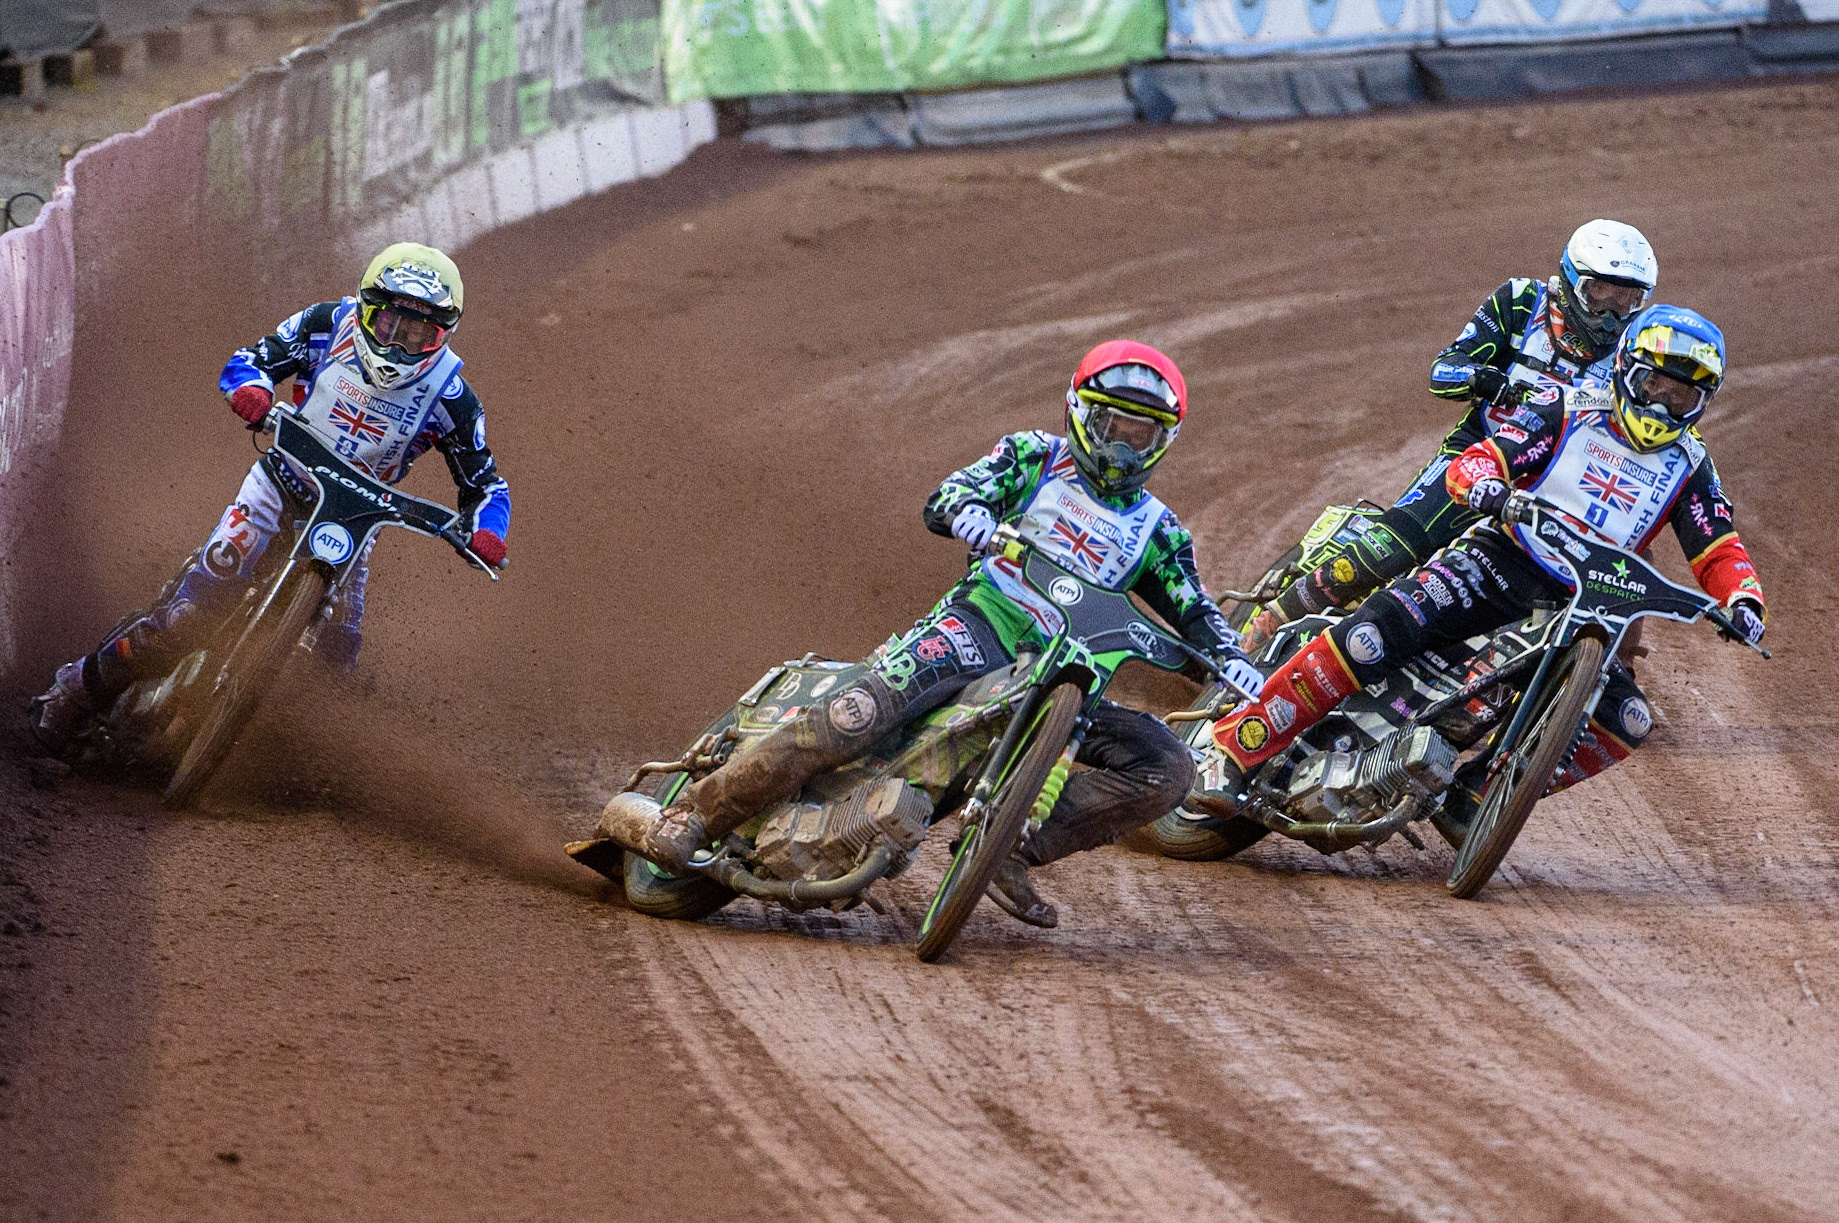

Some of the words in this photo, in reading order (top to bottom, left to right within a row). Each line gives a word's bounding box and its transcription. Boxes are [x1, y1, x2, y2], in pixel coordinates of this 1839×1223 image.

[336, 379, 369, 407] SPORTS
[367, 398, 403, 421] INSURE
[375, 440, 403, 475] ITISH
[399, 384, 430, 436] FINAL
[1586, 442, 1621, 468] SPORTS
[1621, 459, 1656, 485] INSURE
[1650, 451, 1682, 505] FINAL
[1060, 495, 1095, 525] SPORTS
[1093, 519, 1123, 548] INSU
[1117, 512, 1147, 568] FINAL
[316, 533, 345, 554] ATPI
[1470, 547, 1509, 591] STELLAR
[1588, 569, 1647, 595] STELLAR
[1055, 584, 1077, 598] ATPI
[954, 630, 981, 662] FTS
[1355, 632, 1378, 657] ATPI
[845, 697, 863, 725] ATPI
[1626, 707, 1650, 728] ATPI
